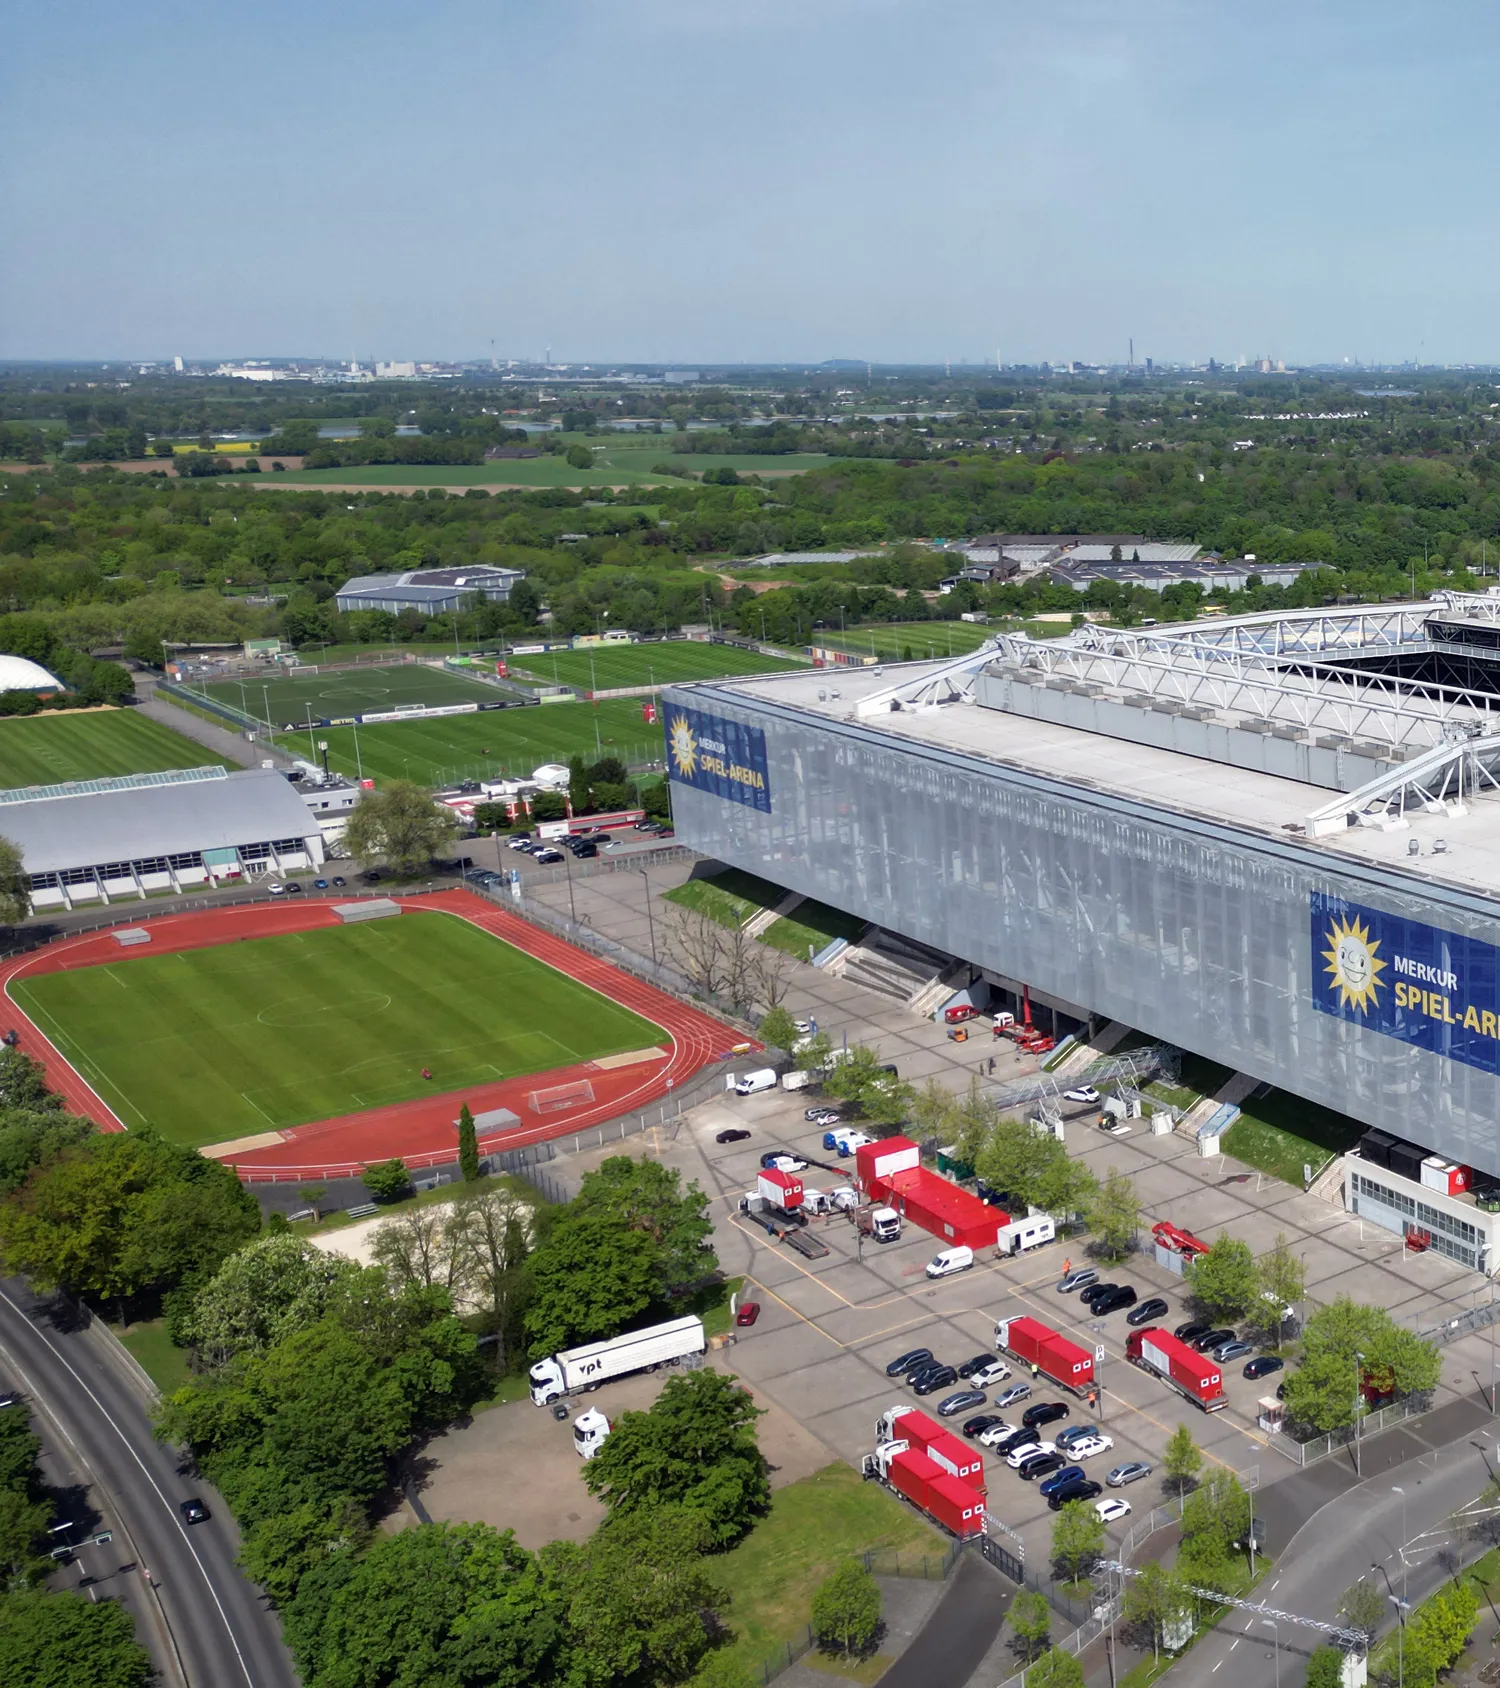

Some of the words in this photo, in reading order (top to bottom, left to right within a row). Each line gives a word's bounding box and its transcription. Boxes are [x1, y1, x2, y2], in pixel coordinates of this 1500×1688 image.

[699, 737, 726, 755] MERKUR
[700, 754, 765, 790] SPIEL-ARENA
[1394, 955, 1458, 991] MERKUR
[579, 1358, 602, 1375] vpt
